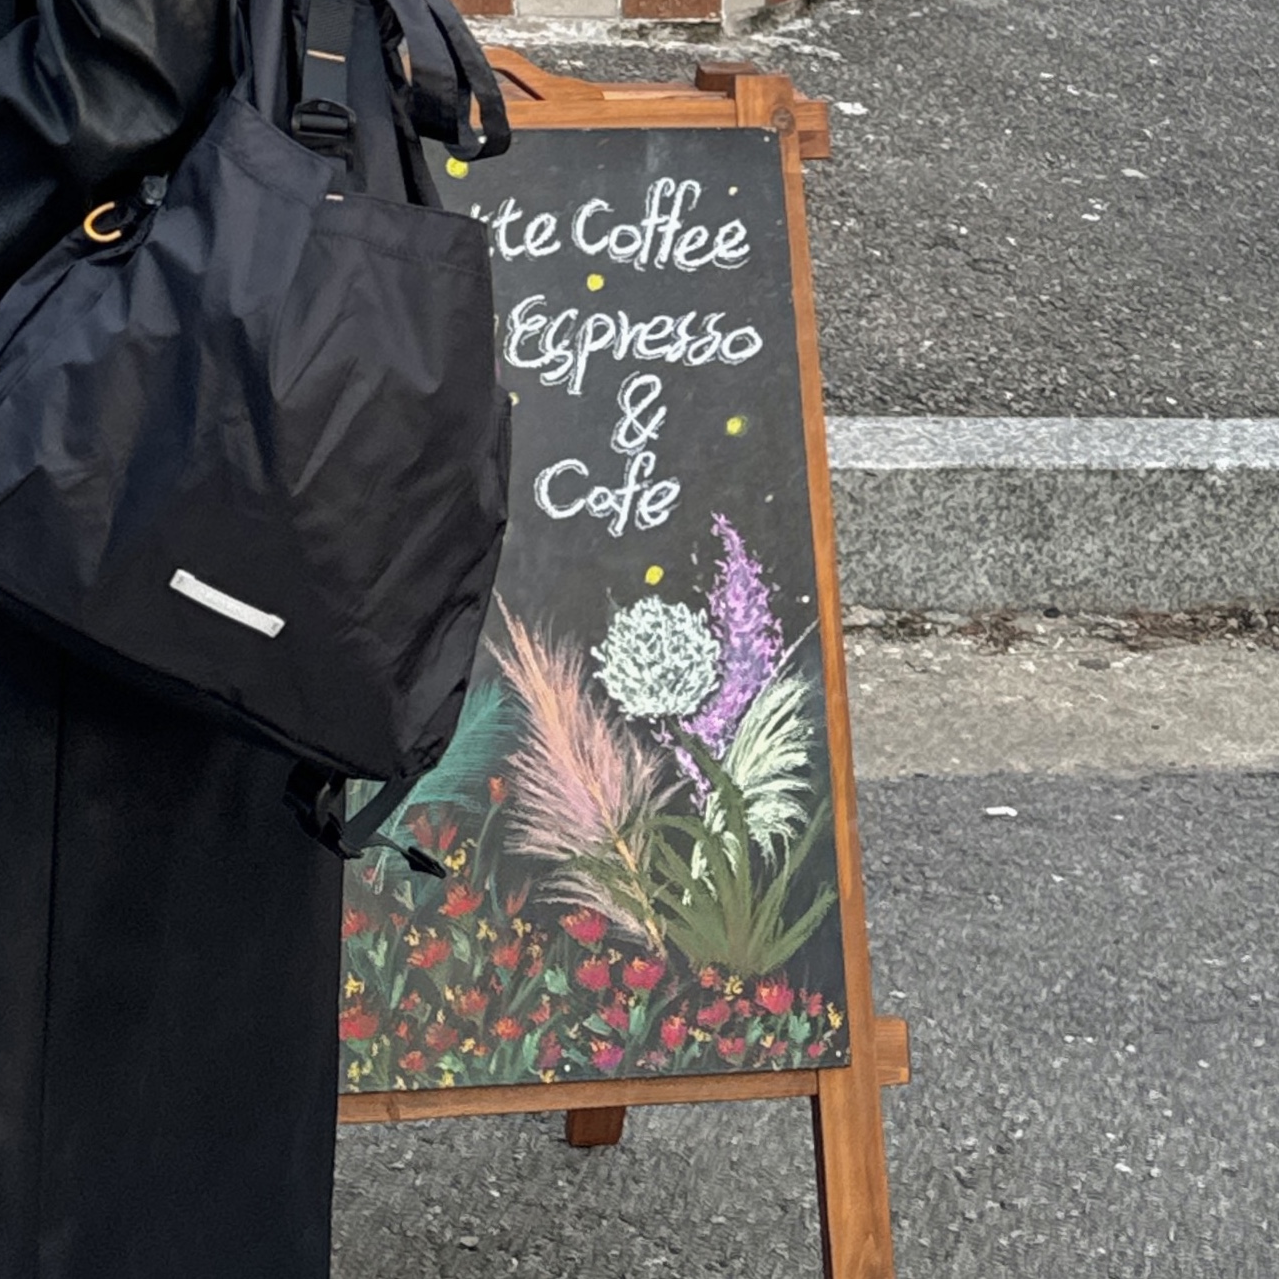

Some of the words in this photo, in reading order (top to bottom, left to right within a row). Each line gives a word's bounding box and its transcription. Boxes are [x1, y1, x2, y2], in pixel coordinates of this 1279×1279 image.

[571, 176, 751, 272] Coffee
[504, 294, 763, 397] Espresso
[610, 371, 668, 456] &
[534, 450, 682, 538] Cafe
